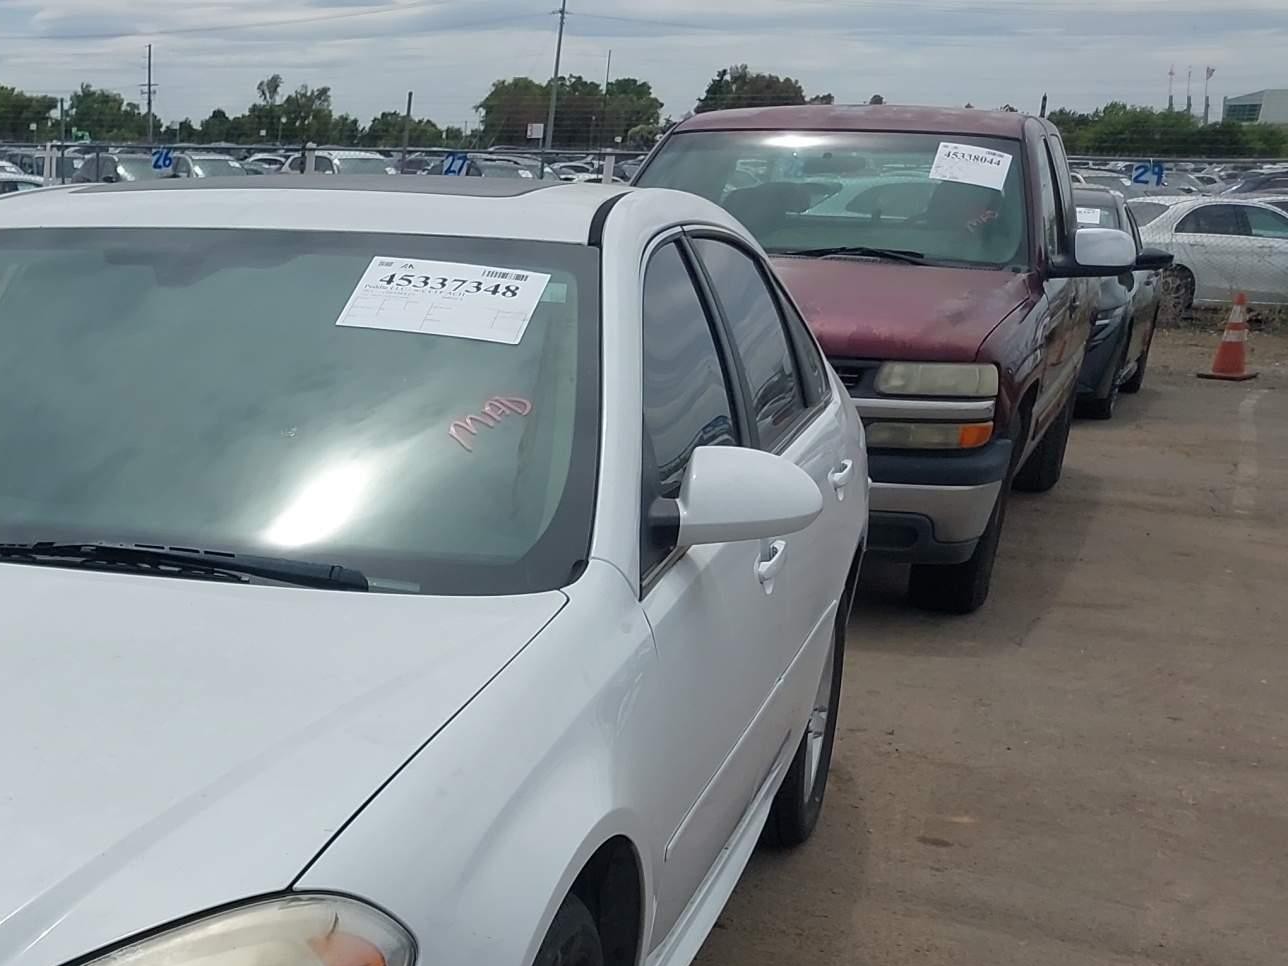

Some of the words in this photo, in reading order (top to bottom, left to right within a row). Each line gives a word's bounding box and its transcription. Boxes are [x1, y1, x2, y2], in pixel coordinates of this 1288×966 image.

[152, 147, 173, 169] 26
[442, 153, 469, 176] 27
[943, 151, 1001, 167] 45338044
[1133, 162, 1164, 186] 29
[379, 272, 521, 299] 45337348
